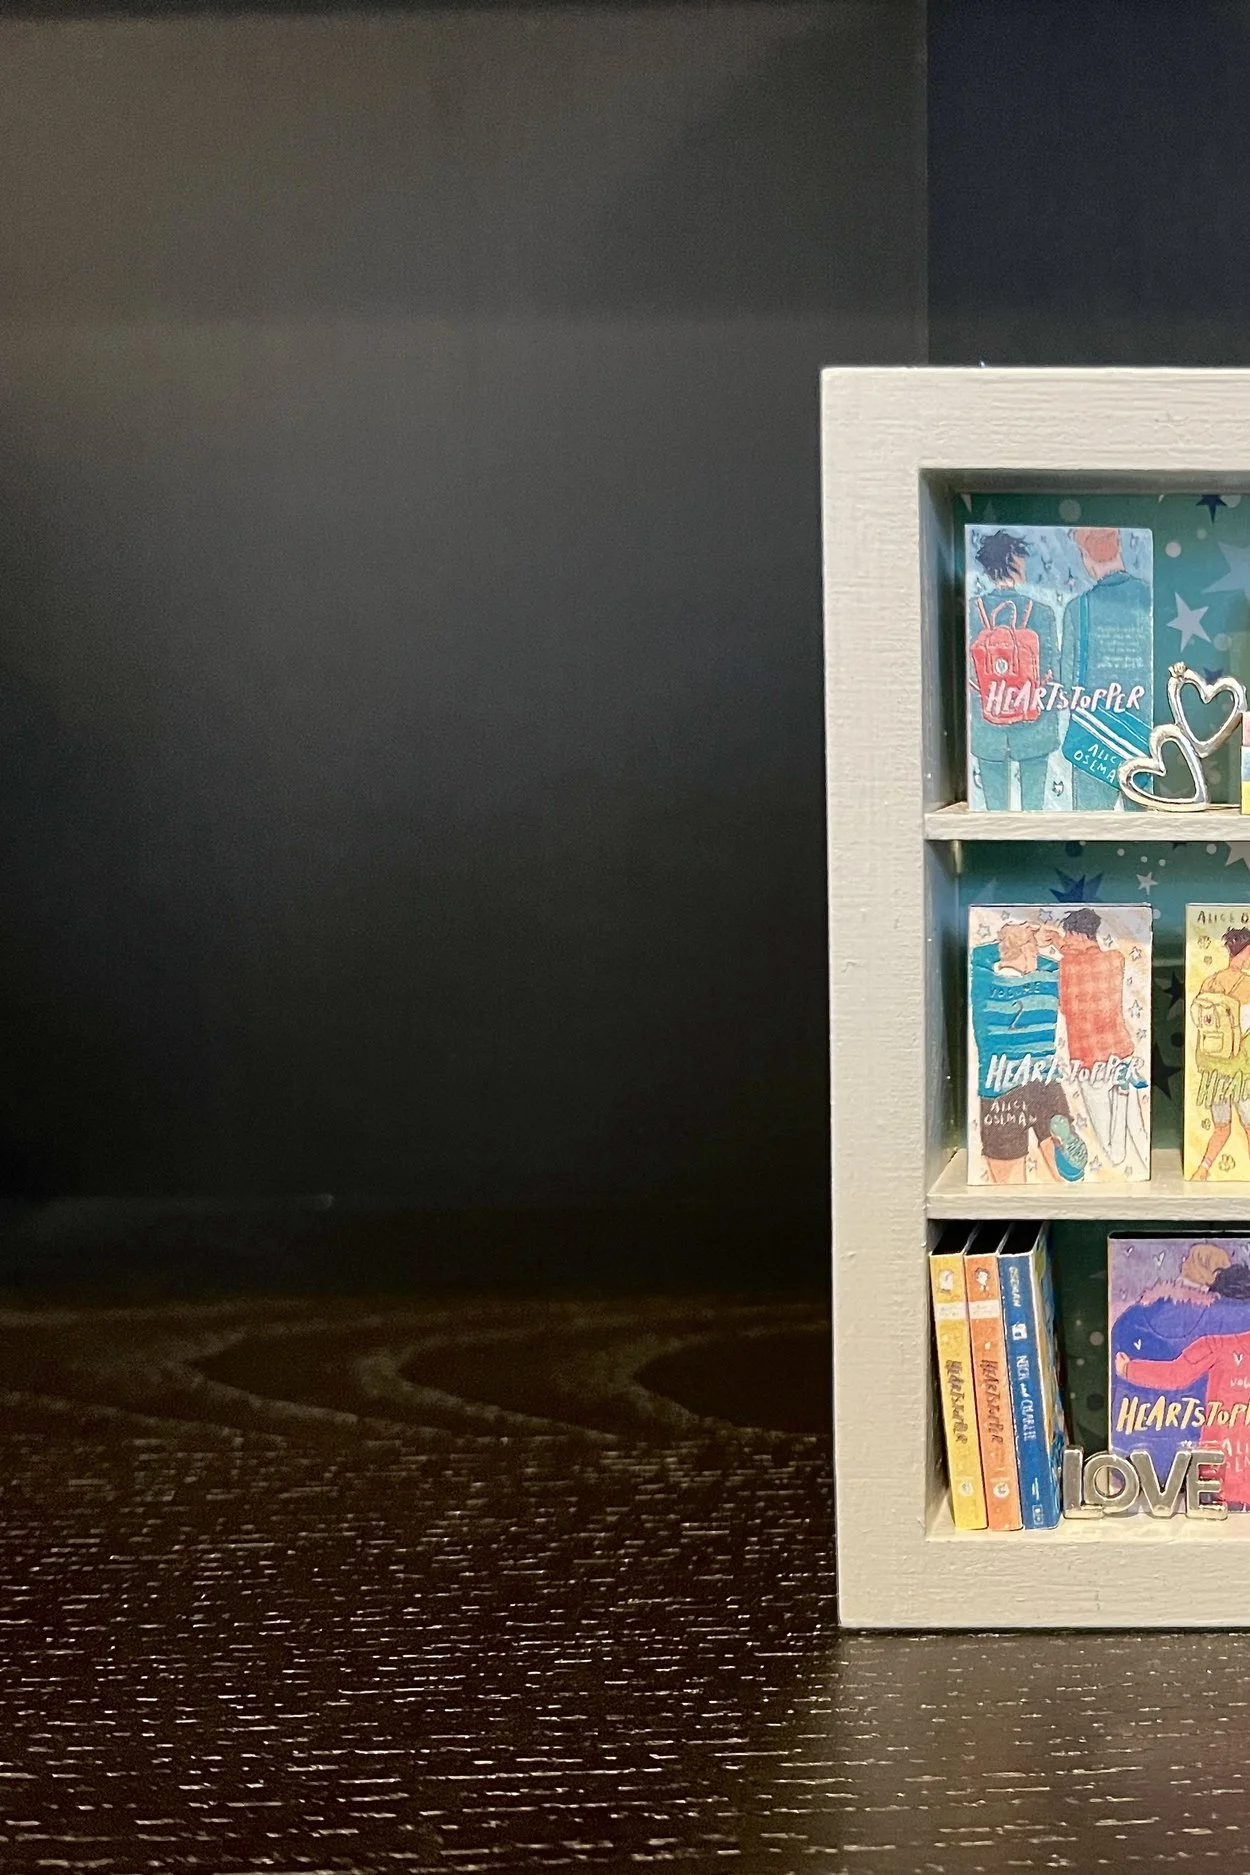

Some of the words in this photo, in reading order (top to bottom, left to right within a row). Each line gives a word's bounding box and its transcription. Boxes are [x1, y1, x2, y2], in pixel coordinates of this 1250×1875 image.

[985, 681, 1146, 714] HEARTSTOPPER
[1073, 750, 1118, 784] OSEMA
[1087, 743, 1121, 765] ALIC
[1197, 910, 1236, 925] ALICE
[1007, 1000, 1028, 1031] 2
[985, 1054, 1146, 1092] HEARTSTOPPER
[945, 1359, 968, 1444] HEARTSTOPPER
[980, 1359, 1004, 1444] HEARTSTOPPER
[1062, 1446, 1228, 1519] LOVE
